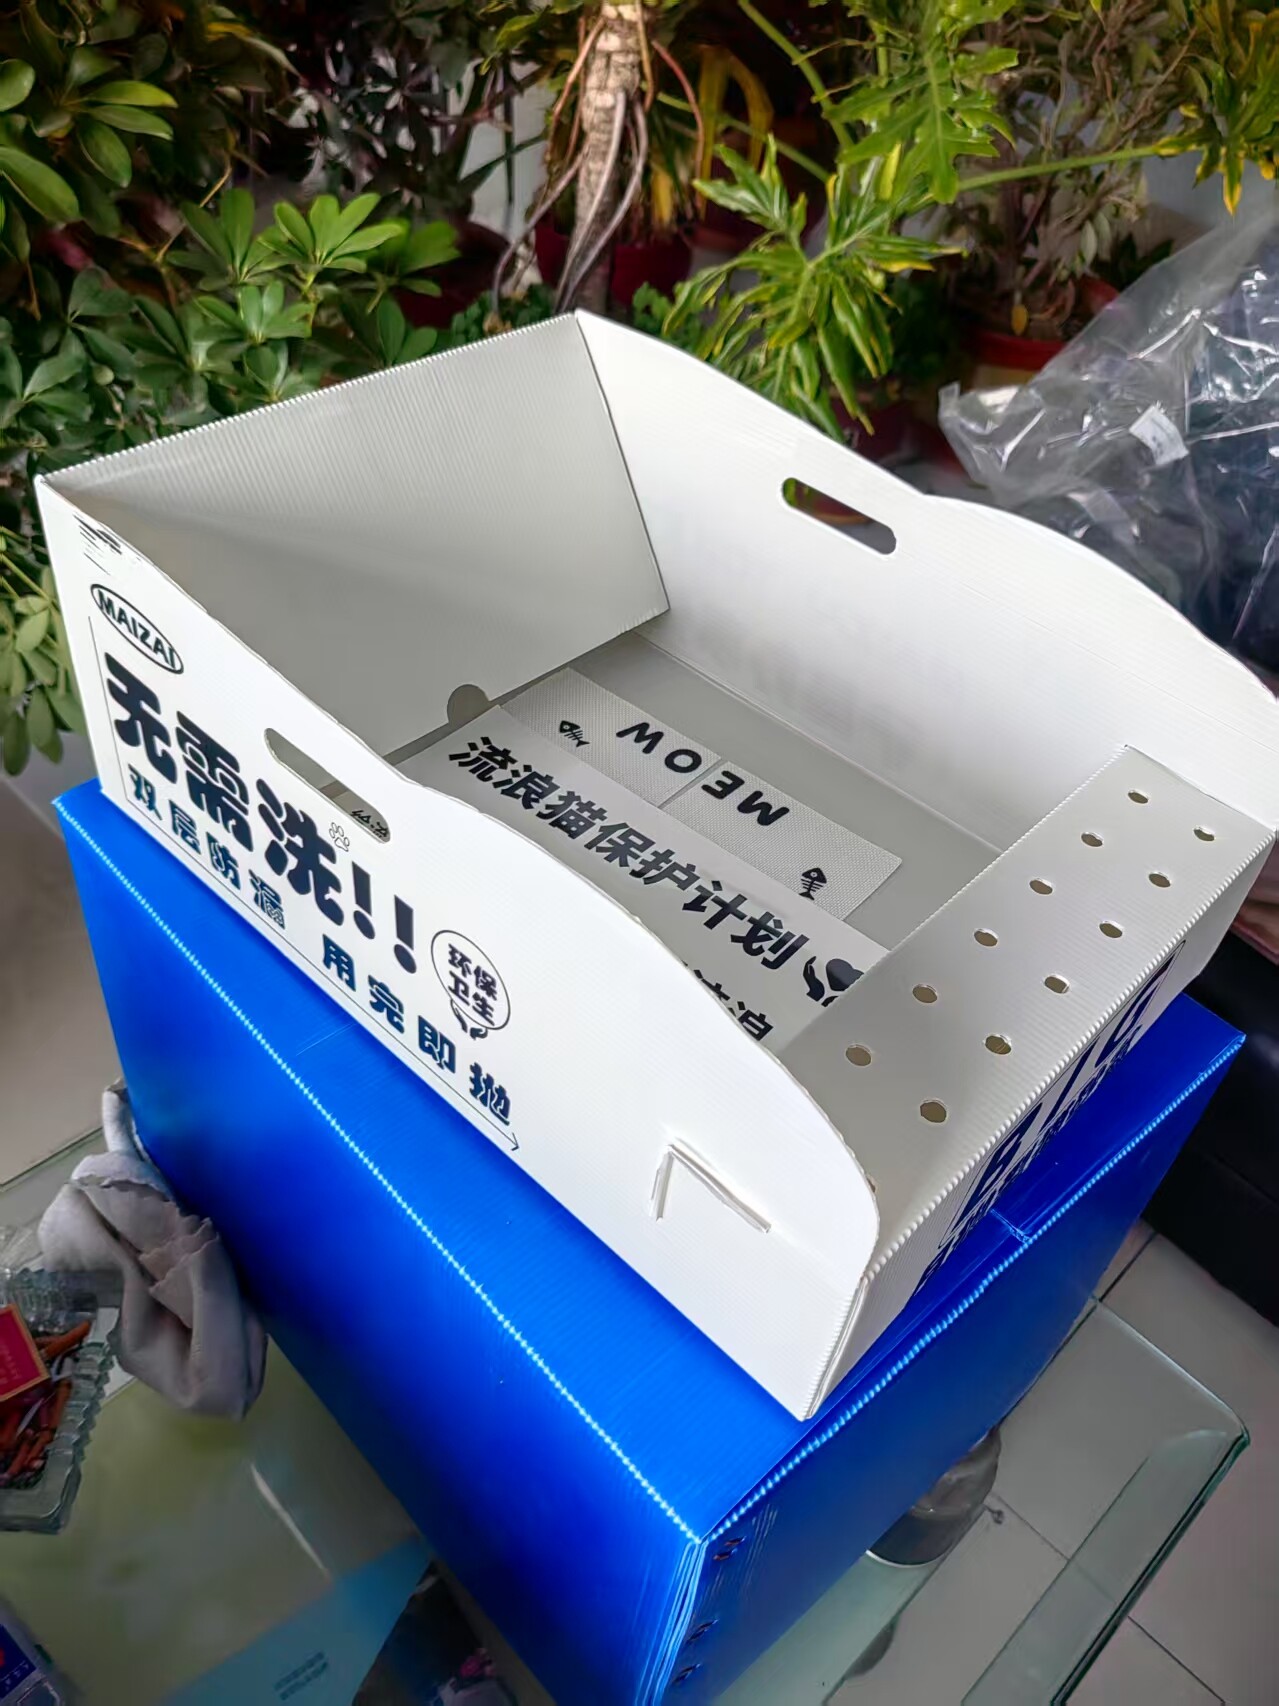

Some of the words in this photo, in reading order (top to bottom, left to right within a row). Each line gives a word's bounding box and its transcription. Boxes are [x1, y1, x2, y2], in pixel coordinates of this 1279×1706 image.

[98, 589, 177, 669] MAIZAI
[616, 721, 790, 827] MEOW
[449, 736, 810, 970] 流浪猫保护计划
[448, 943, 498, 1001] 环保
[448, 970, 496, 1027] 卫生
